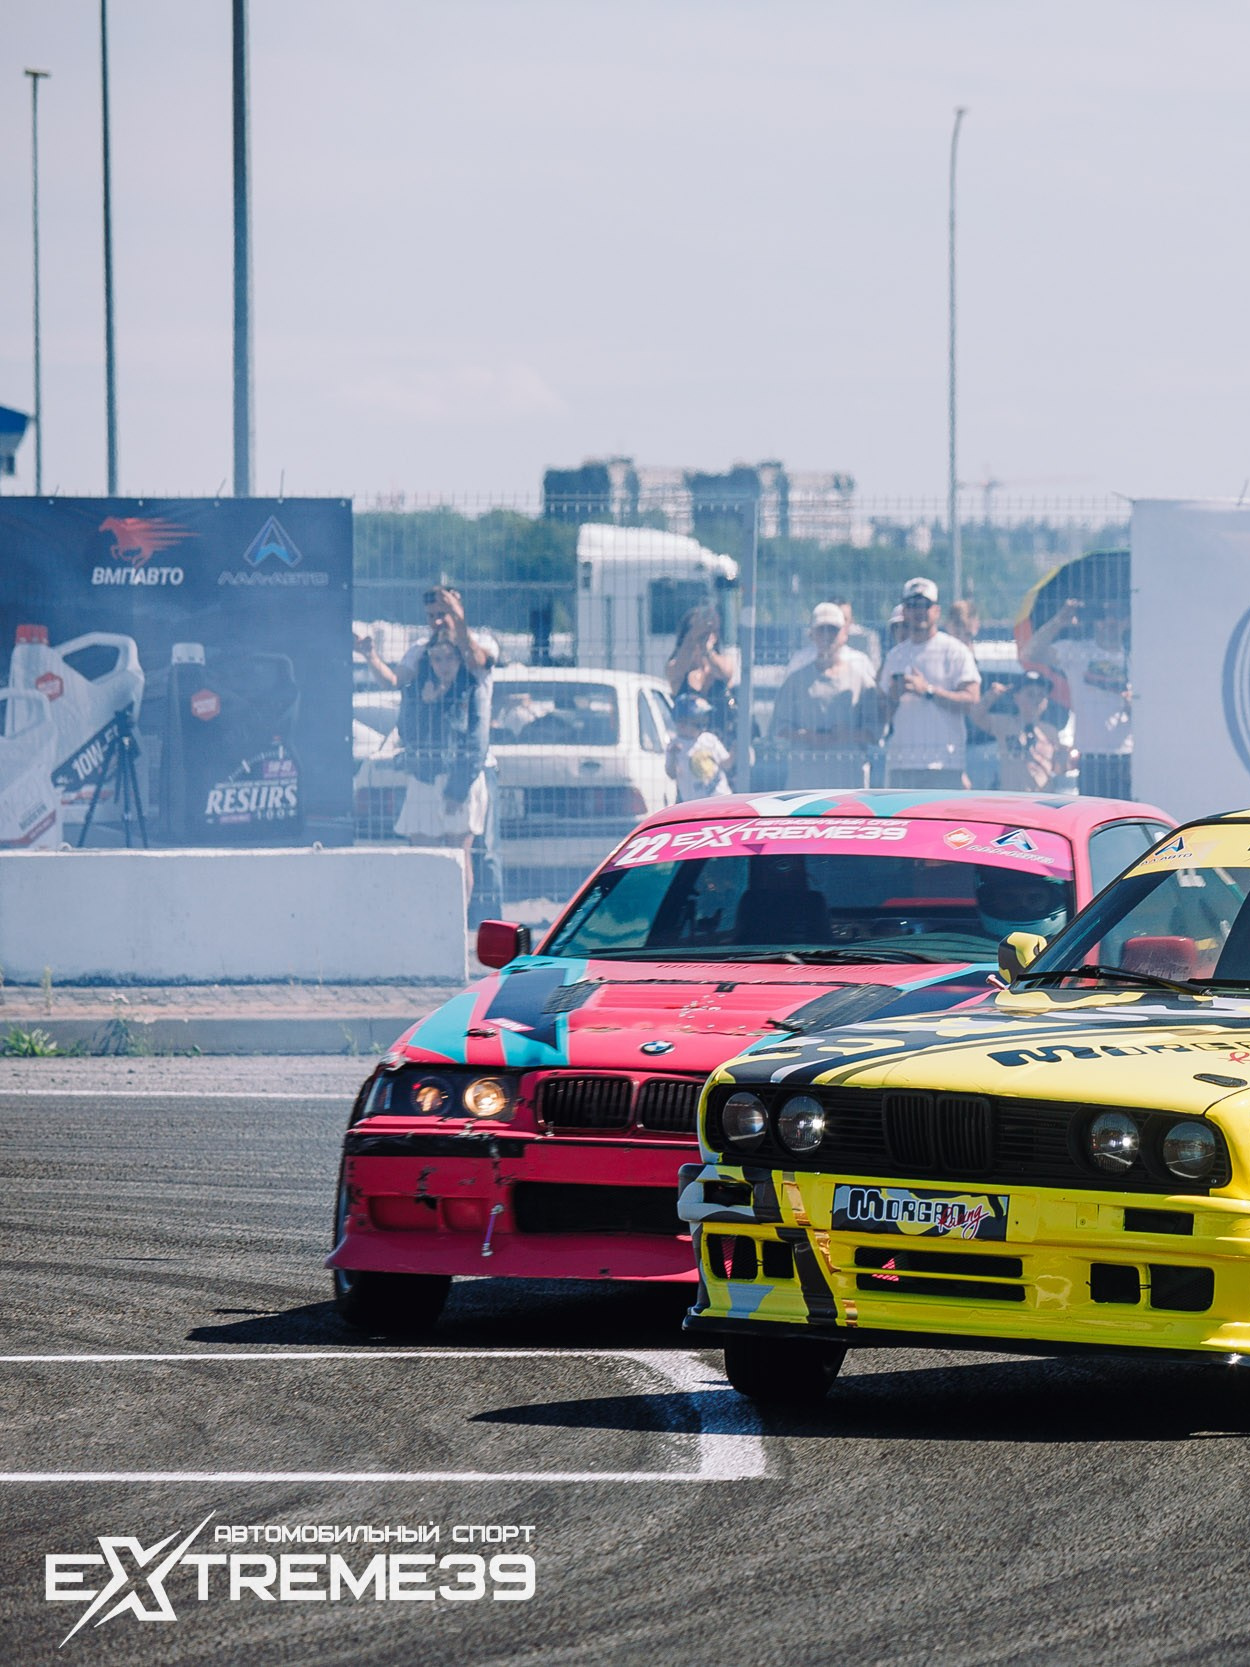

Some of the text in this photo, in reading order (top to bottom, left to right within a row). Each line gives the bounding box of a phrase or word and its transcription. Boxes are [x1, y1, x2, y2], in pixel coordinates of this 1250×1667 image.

[92, 567, 184, 586] ВМПАВТО
[205, 784, 298, 815] RESURS
[614, 832, 671, 867] 22
